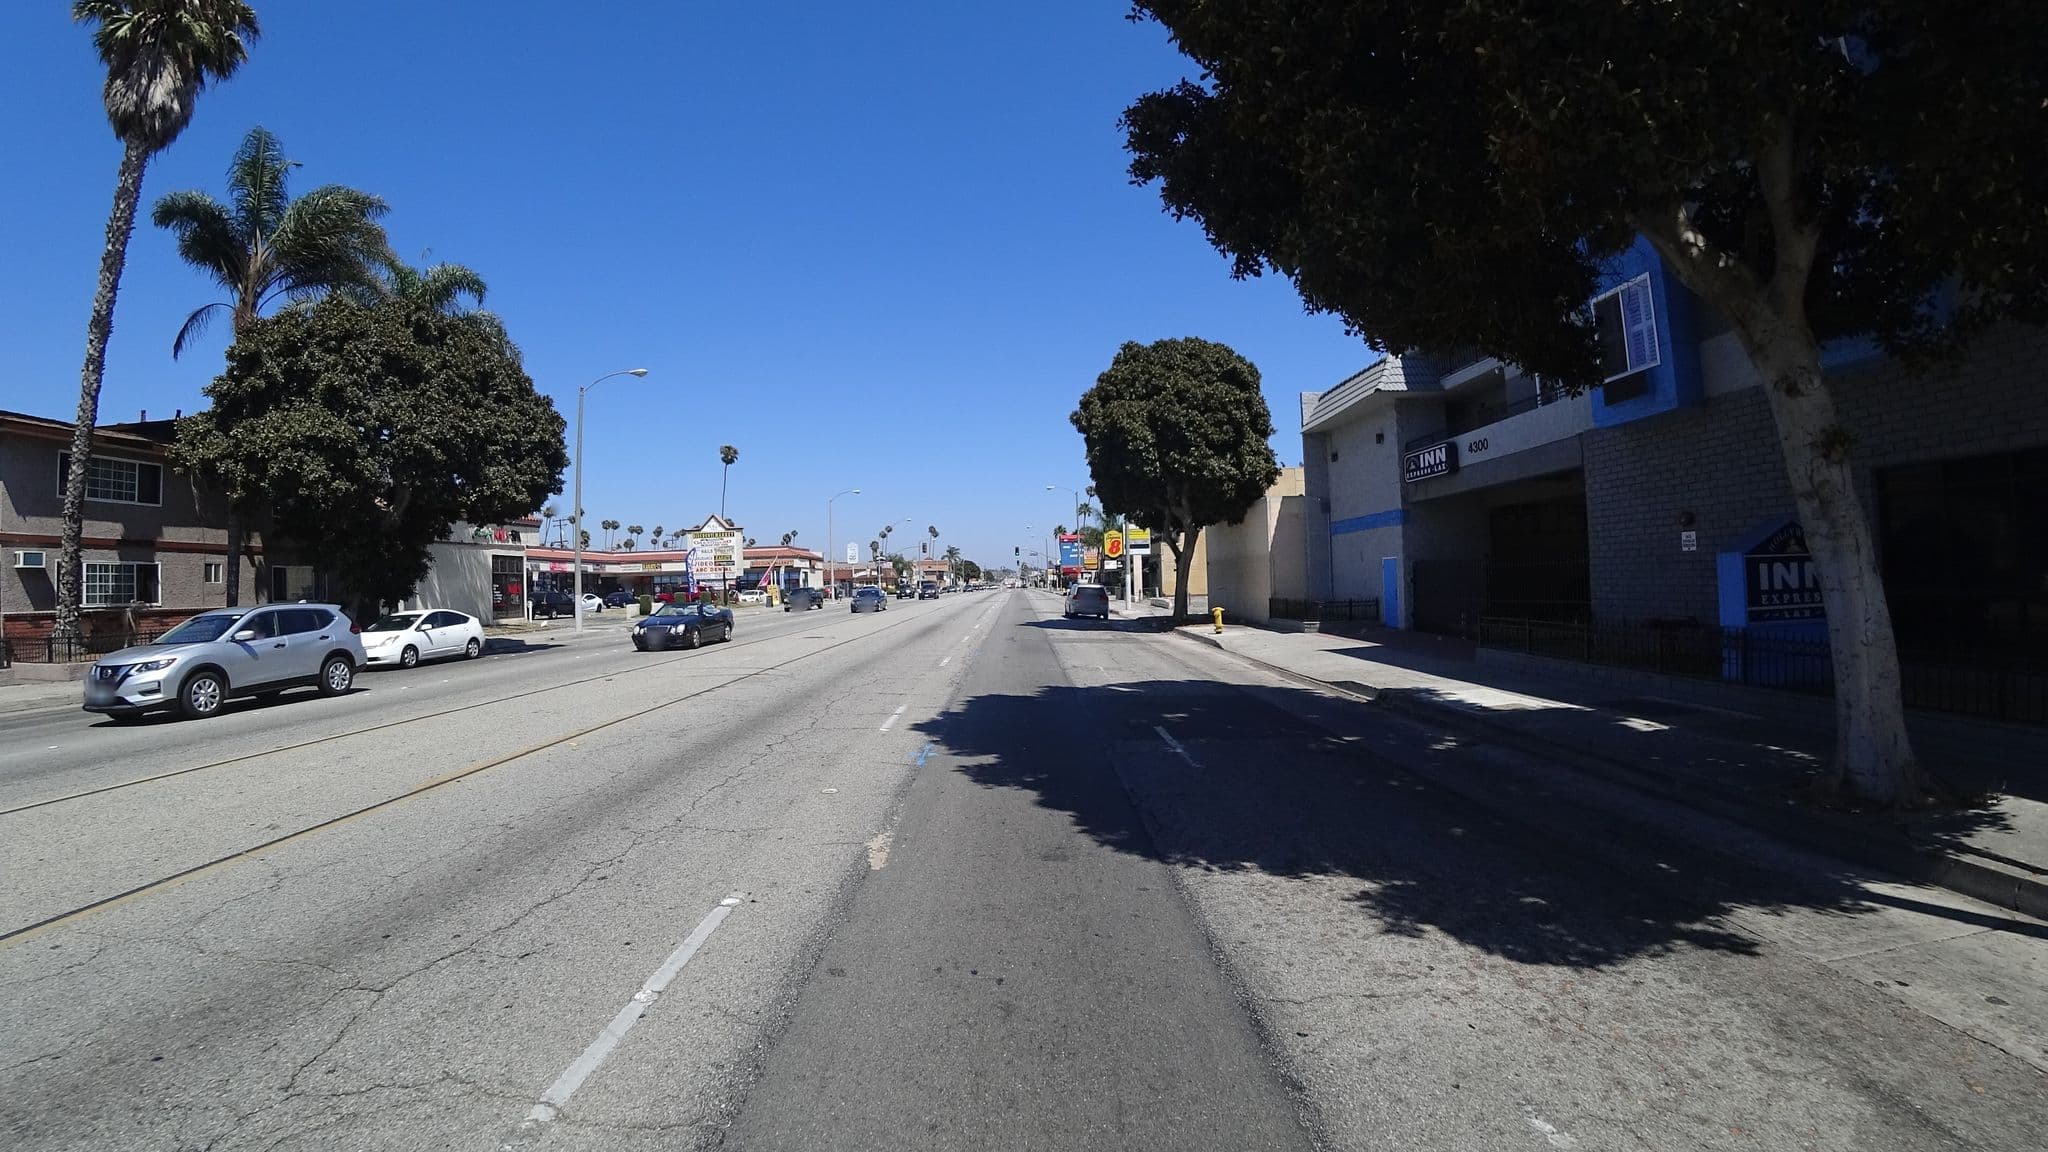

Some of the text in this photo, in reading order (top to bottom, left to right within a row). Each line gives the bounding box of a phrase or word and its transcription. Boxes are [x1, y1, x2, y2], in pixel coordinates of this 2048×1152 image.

[1468, 438, 1489, 454] 4300
[1419, 447, 1446, 468] INN
[1109, 539, 1121, 554] 8
[1760, 591, 1822, 605] EXPRES
